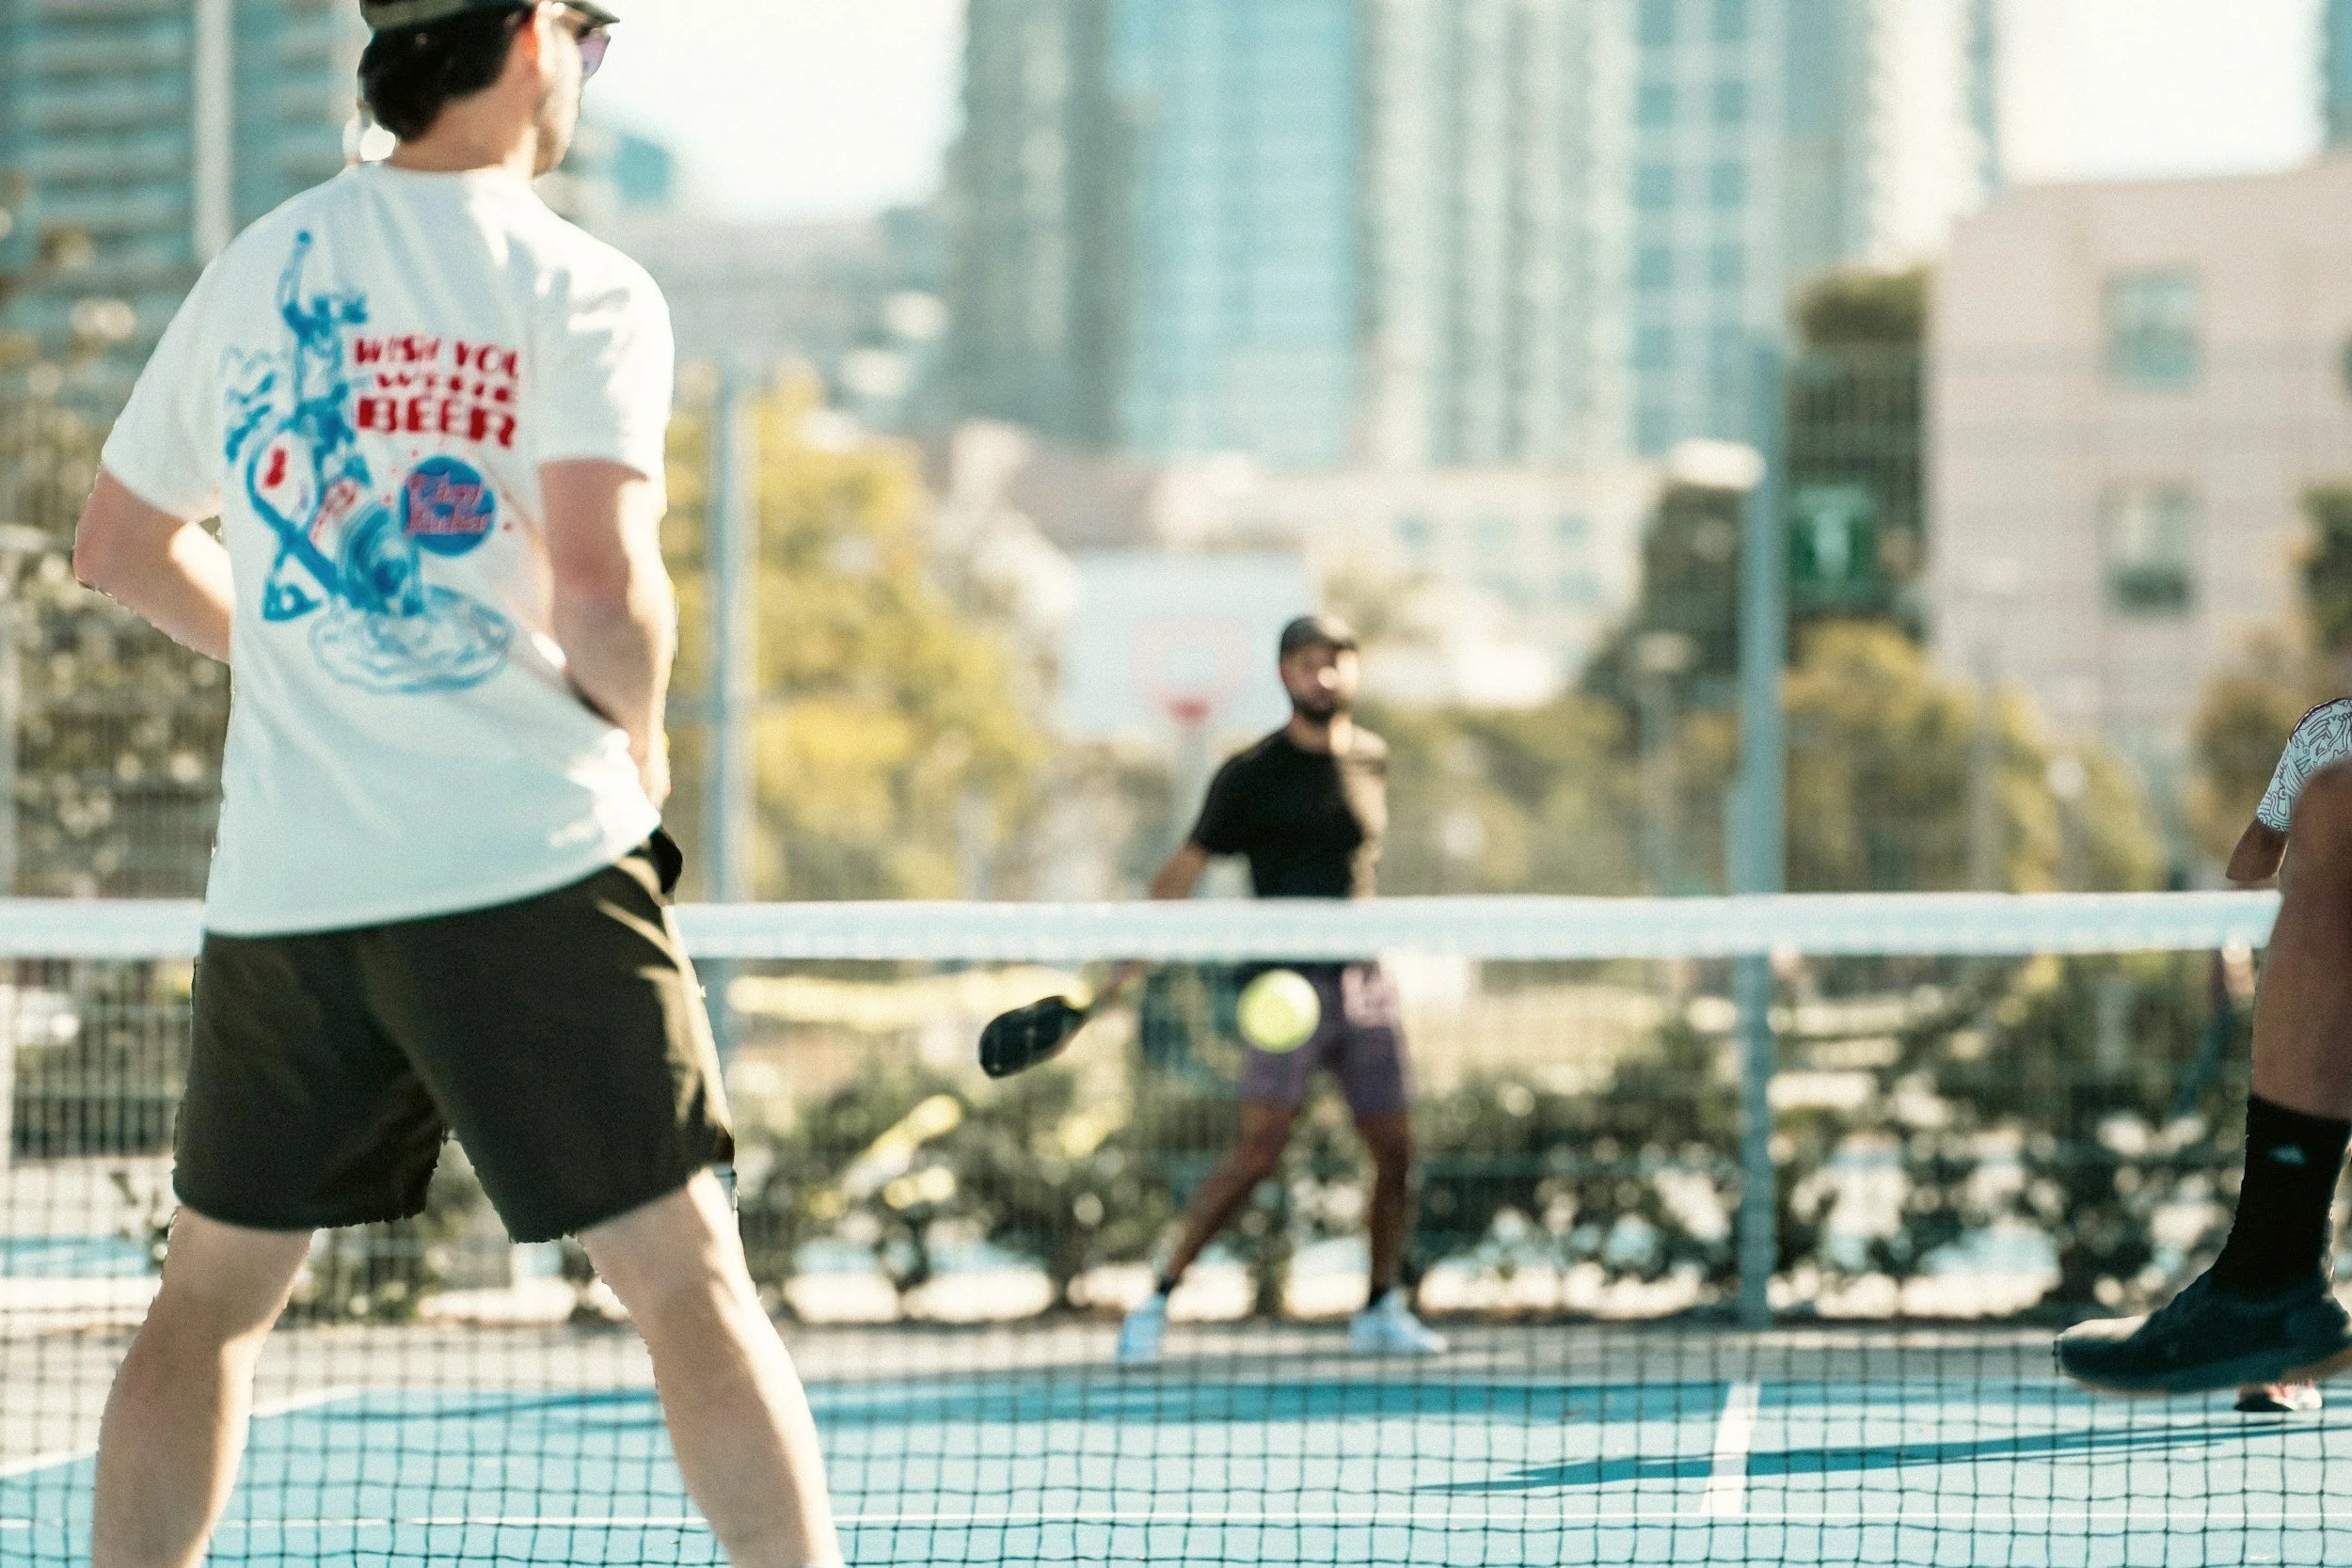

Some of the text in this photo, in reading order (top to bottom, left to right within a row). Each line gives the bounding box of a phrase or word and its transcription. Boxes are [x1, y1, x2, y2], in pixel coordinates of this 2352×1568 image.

[356, 336, 516, 378] WISH YOU
[356, 396, 516, 449] BEER
